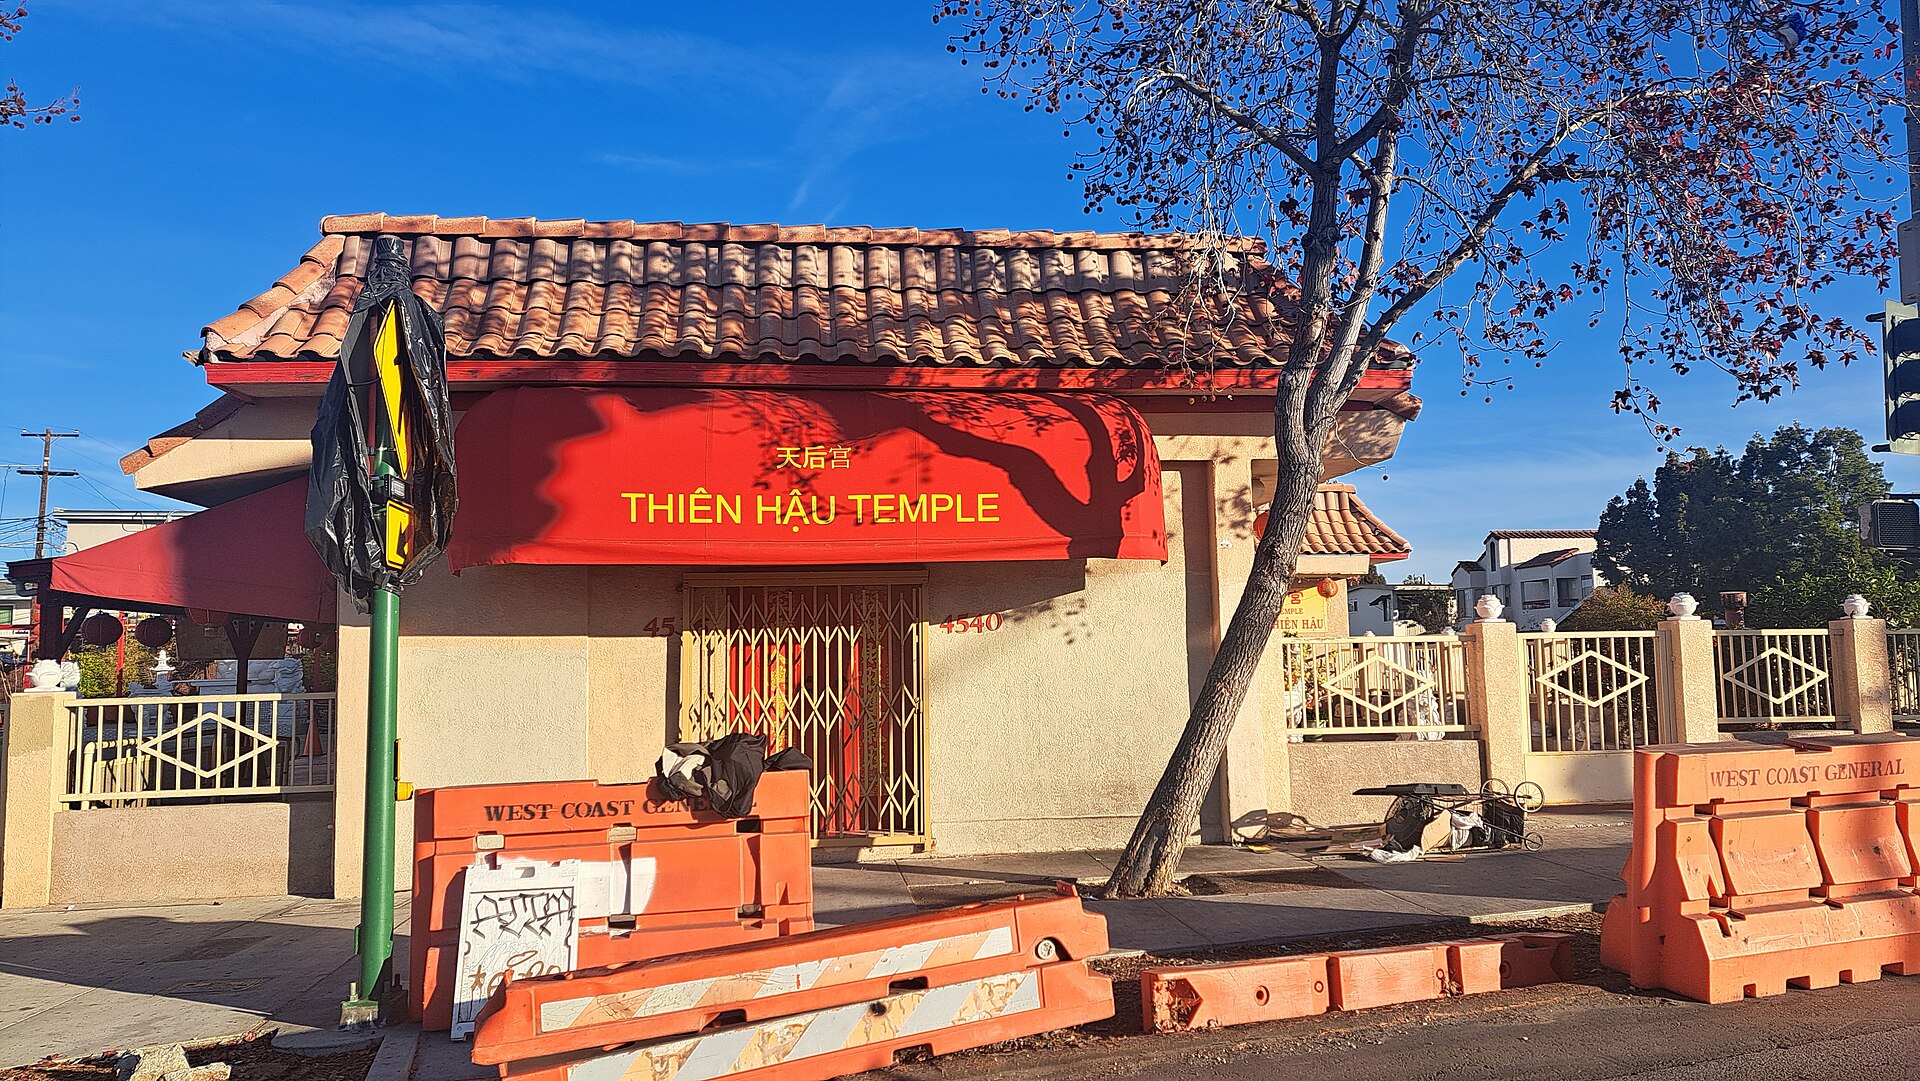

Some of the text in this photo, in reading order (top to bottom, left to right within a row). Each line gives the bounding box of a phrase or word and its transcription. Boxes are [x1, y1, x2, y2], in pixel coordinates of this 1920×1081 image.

[776, 445, 852, 469] 天后宫
[621, 487, 1000, 533] THIÊN HẬU TEMPLE
[1279, 607, 1304, 615] EMPLE
[940, 612, 1003, 635] 4540
[1271, 616, 1324, 632] HIÊN HẬU
[1710, 758, 1906, 788] WEST COAST GENERAL
[484, 803, 553, 821] WEST
[561, 800, 635, 819] COAST
